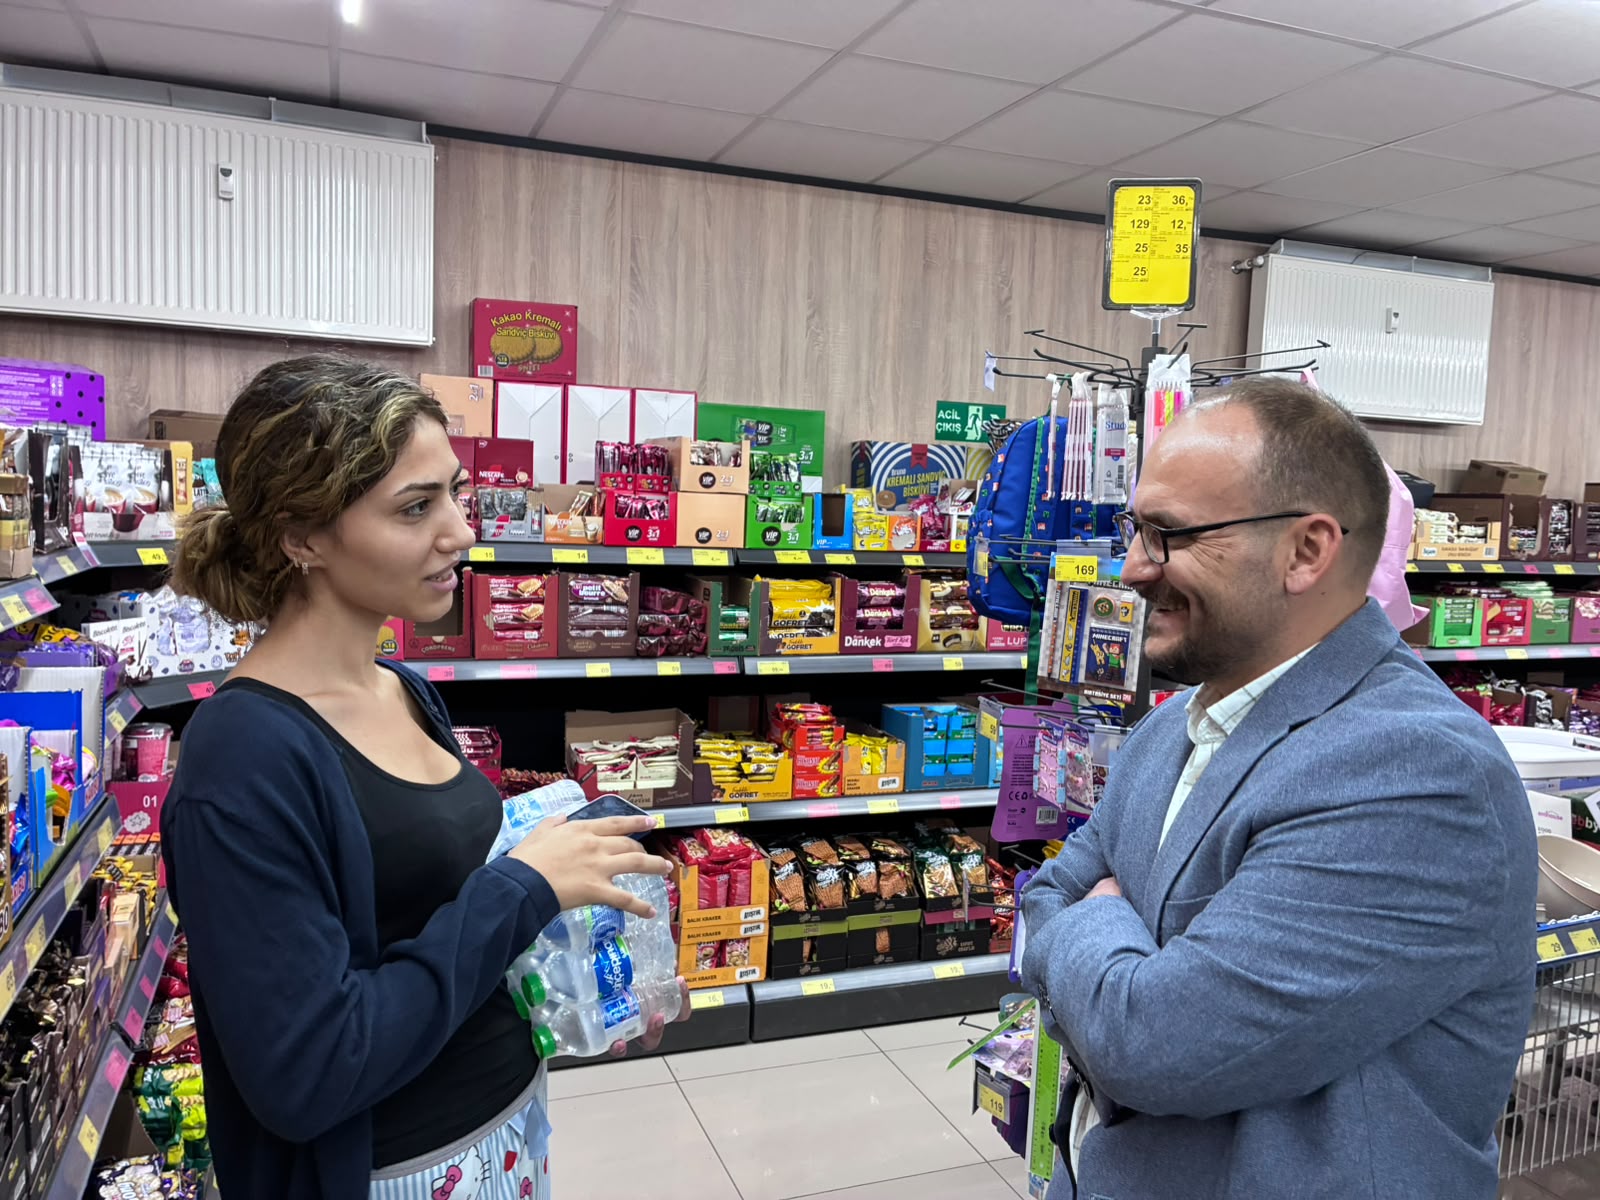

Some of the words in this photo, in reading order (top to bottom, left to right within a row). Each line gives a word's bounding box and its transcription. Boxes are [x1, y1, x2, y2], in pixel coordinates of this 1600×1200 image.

[1131, 219, 1150, 229] 129
[490, 312, 523, 327] Kakao
[525, 311, 562, 331] Kremalı
[496, 327, 527, 339] Sandviç
[938, 410, 961, 420] ACİL
[936, 422, 961, 434] ÇIKIŞ
[887, 474, 916, 488] KREMALI
[1075, 565, 1094, 575] 169
[844, 635, 882, 648] Dankek
[1092, 633, 1127, 643] MINECRAFT
[728, 791, 759, 799] GOFRET
[143, 796, 158, 808] 01
[990, 1099, 1003, 1112] 119
